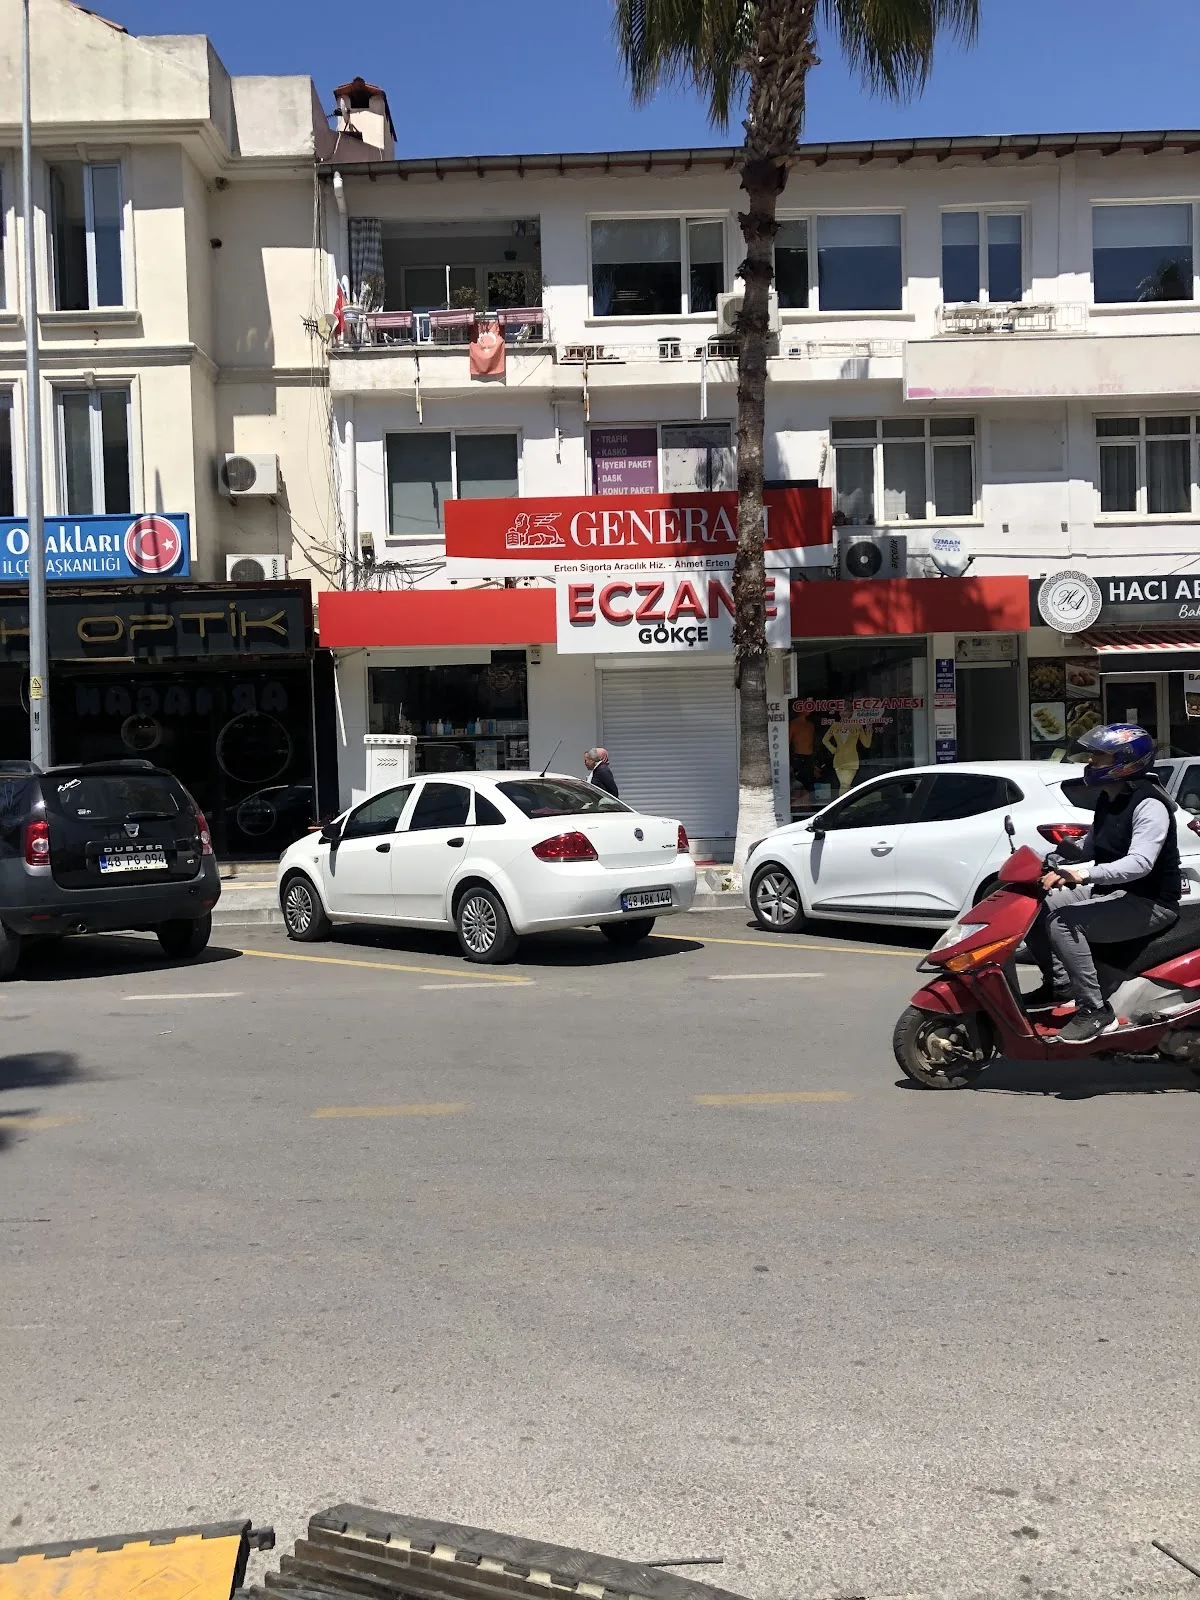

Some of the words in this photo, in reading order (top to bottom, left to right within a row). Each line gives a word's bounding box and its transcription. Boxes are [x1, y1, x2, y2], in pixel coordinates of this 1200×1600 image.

[601, 434, 629, 444] TRAFİK
[602, 448, 627, 456] KASKO
[602, 460, 627, 471] İŞYERİ
[628, 460, 653, 469] PAKET
[602, 474, 623, 483] DASK
[602, 487, 629, 495] KONUT
[629, 486, 655, 495] PAKET
[569, 505, 774, 548] GENERAI
[45, 554, 120, 577] AŞKANLIĞI
[554, 563, 578, 573] Erten
[580, 563, 612, 573] Sigorta
[674, 560, 703, 569] Ahmet
[705, 559, 730, 568] Erten
[1109, 580, 1168, 601] HACI
[77, 603, 287, 643] OPTİK
[638, 624, 709, 646] GÖKÇE
[792, 698, 846, 714] GÖKÇE
[852, 697, 924, 711] ECZANESİ
[104, 844, 163, 853] DUSTER
[108, 856, 121, 867] 48
[144, 853, 165, 865] 094
[628, 896, 638, 907] 48
[640, 893, 655, 906] ABK
[656, 891, 671, 903] 144
